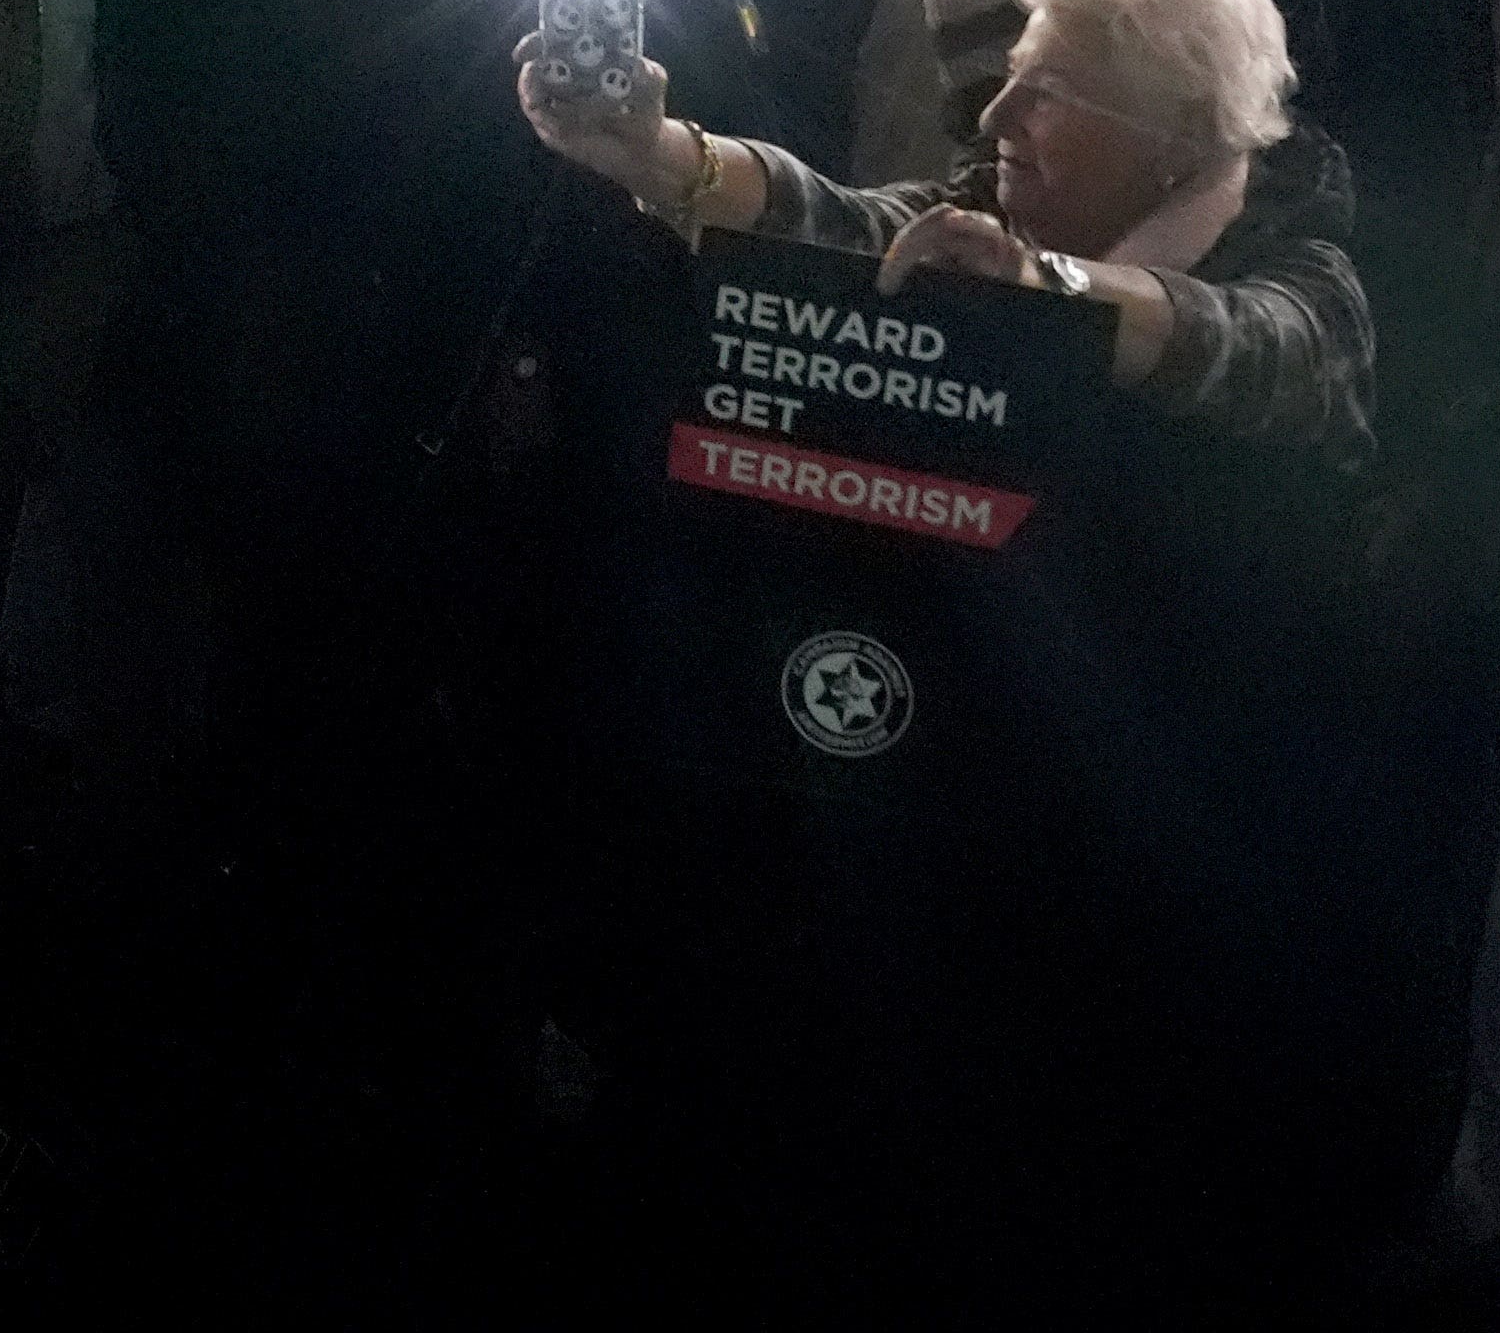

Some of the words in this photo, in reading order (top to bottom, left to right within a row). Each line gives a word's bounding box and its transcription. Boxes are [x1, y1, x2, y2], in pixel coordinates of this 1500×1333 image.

[715, 284, 946, 362] REWARD
[704, 383, 805, 433] GET
[711, 334, 1008, 427] TERRORISM
[700, 439, 992, 534] TERRORISM
